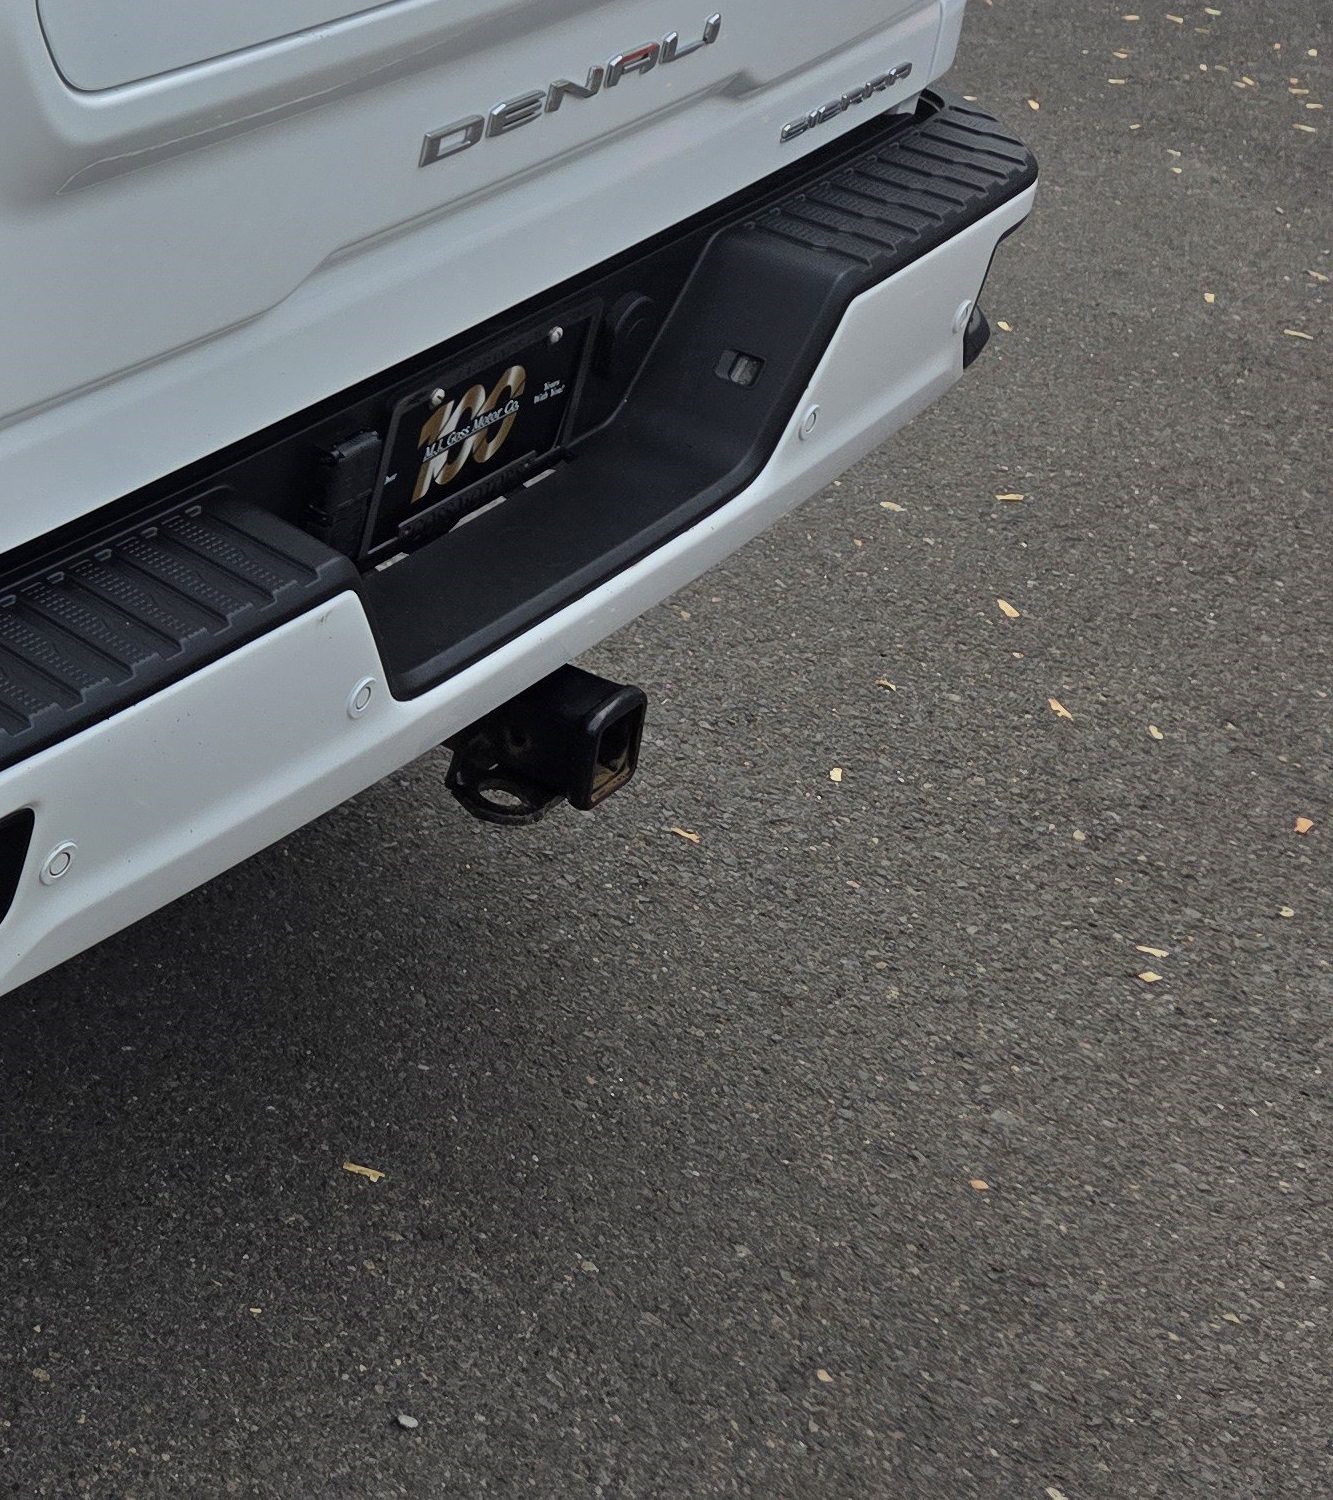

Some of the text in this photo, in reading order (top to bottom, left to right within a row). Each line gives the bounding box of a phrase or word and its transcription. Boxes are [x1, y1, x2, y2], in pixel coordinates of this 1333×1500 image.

[418, 12, 722, 169] DENALI
[779, 62, 913, 143] SIERRA
[410, 364, 527, 505] 100
[447, 425, 471, 445] Goss
[472, 407, 503, 432] Motor
